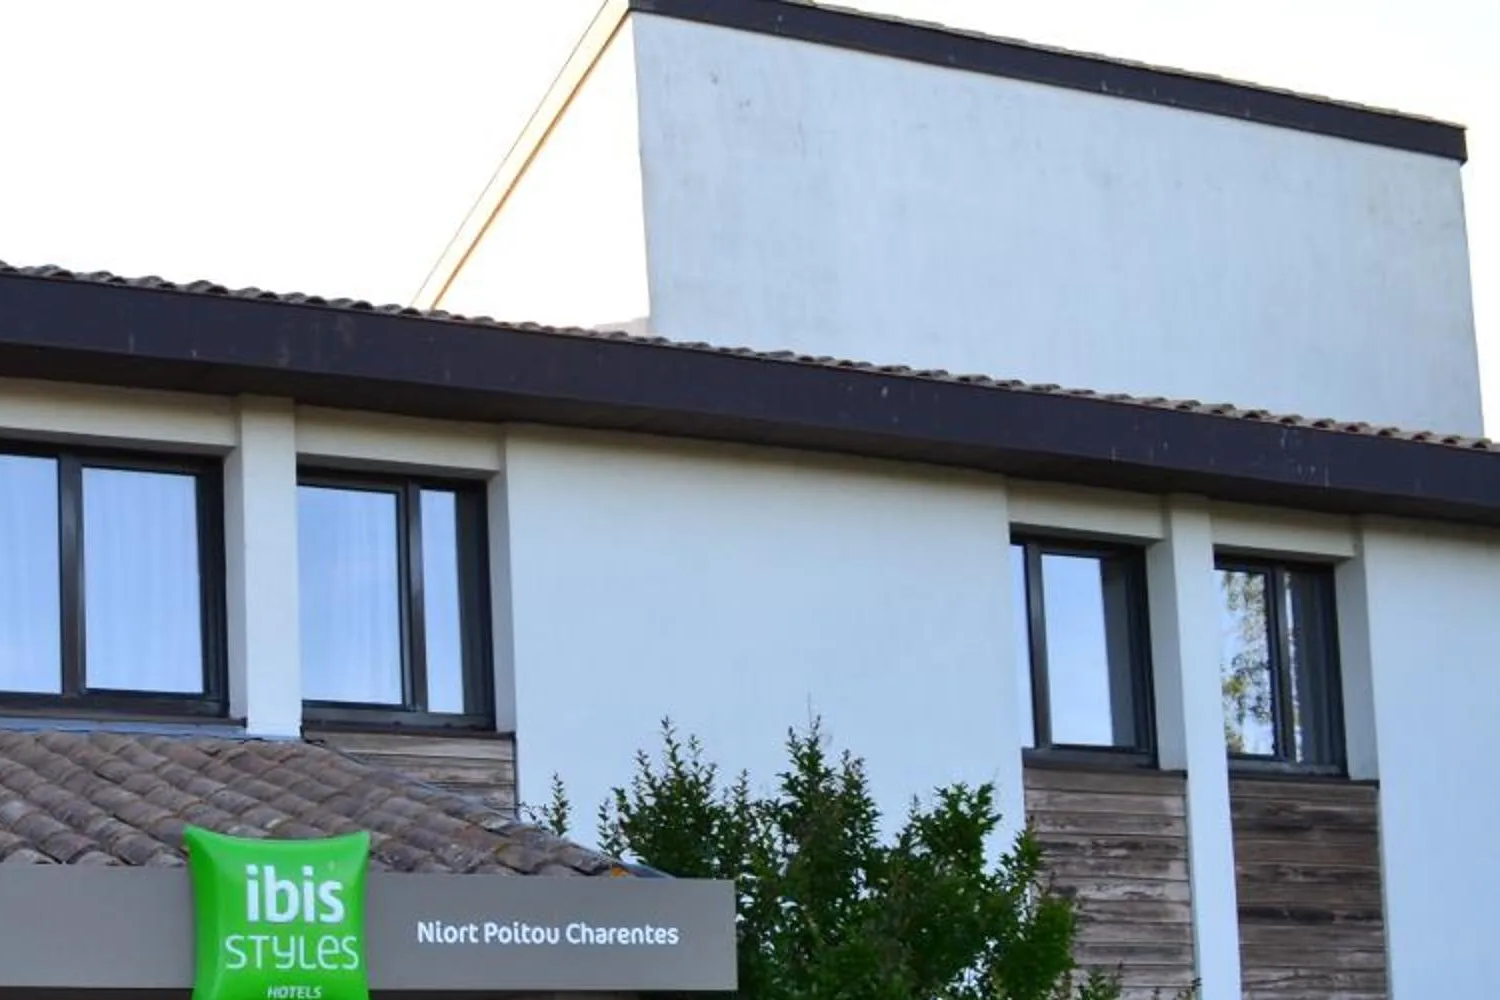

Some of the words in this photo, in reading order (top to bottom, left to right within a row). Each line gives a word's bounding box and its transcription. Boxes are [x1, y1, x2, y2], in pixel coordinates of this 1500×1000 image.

[245, 864, 345, 923] ibis
[417, 920, 479, 944] Niort
[484, 921, 559, 946] Poitou
[565, 922, 680, 946] Charentes
[267, 985, 322, 1000] HOTELS
